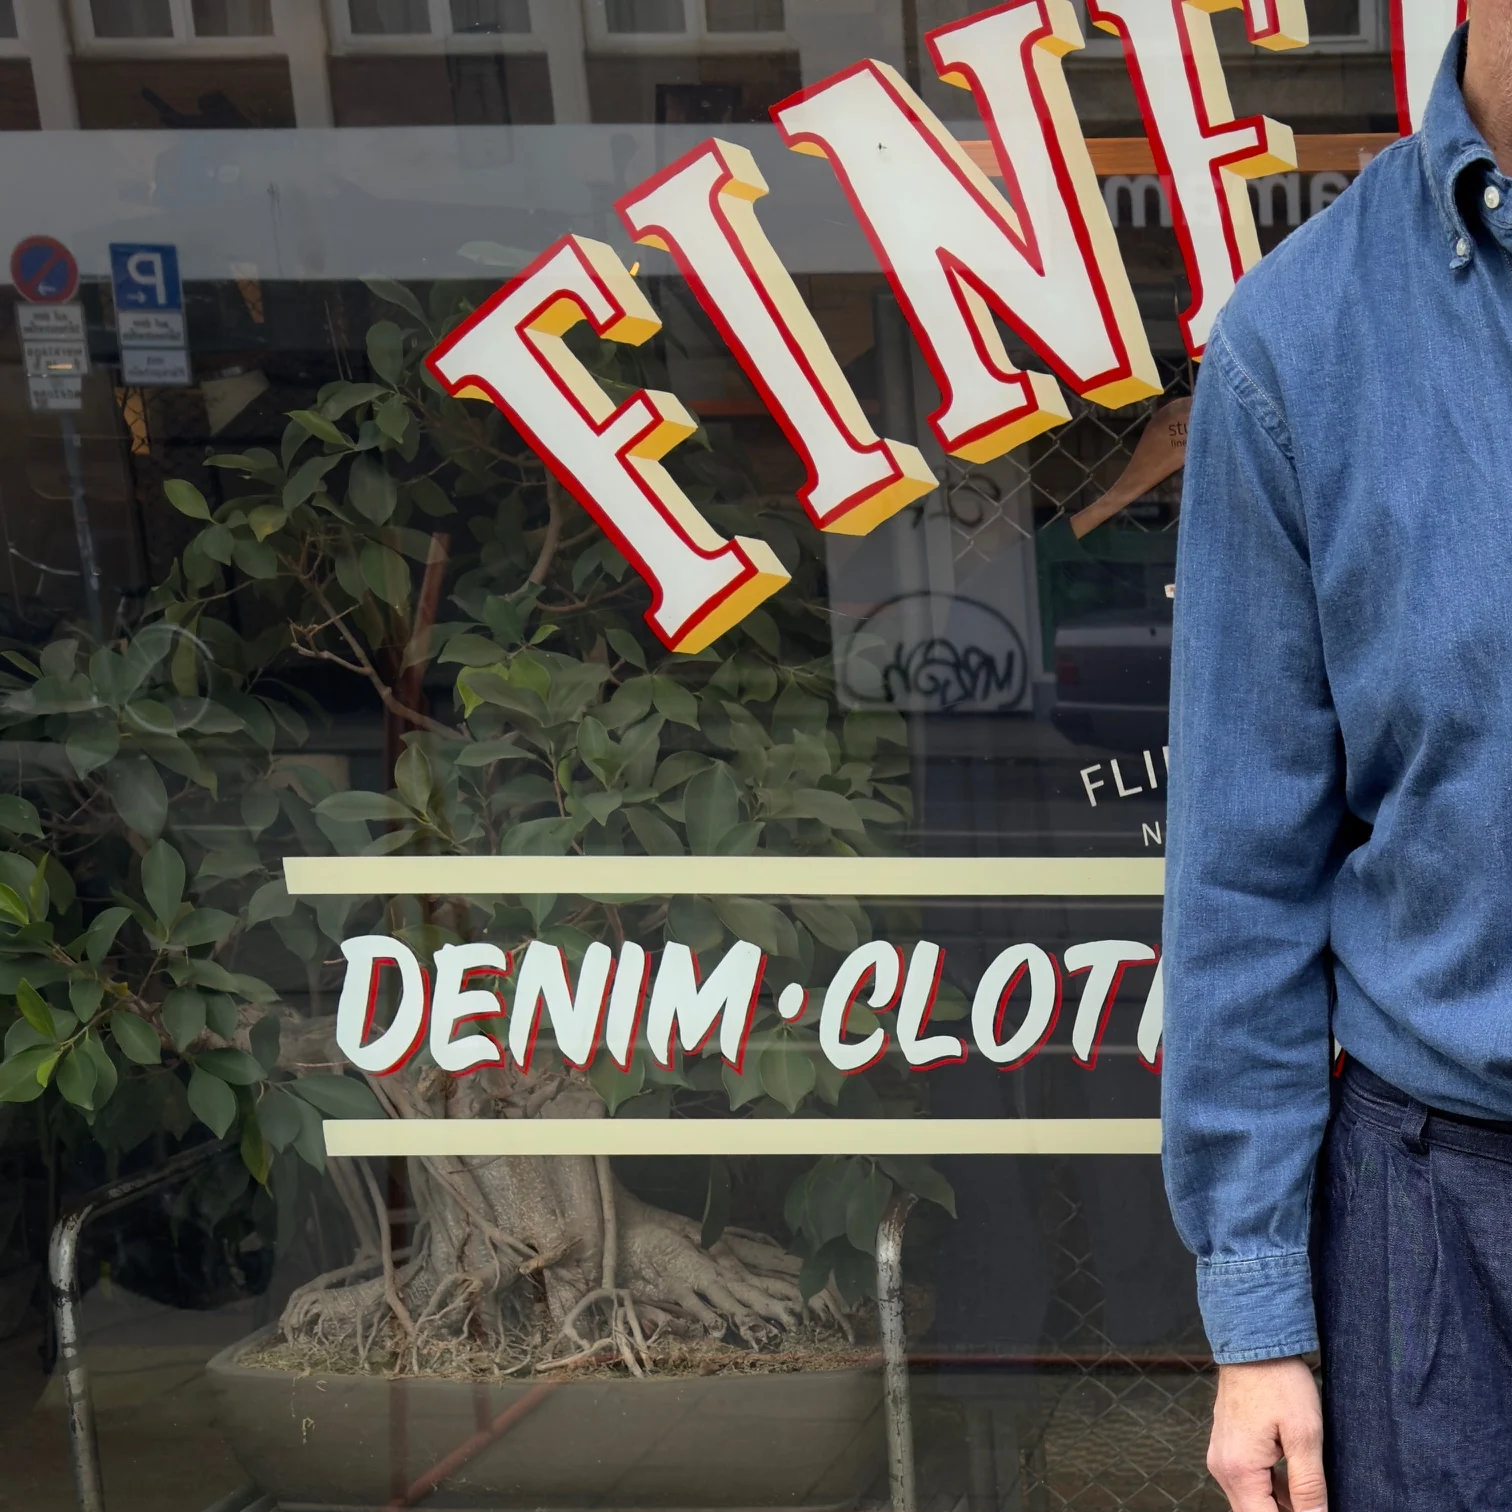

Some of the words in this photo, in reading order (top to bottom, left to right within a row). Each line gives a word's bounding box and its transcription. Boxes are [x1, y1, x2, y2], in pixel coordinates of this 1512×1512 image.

[427, 0, 1309, 654] FINE
[1080, 746, 1168, 807] FLI
[336, 934, 766, 1077] DENIM
